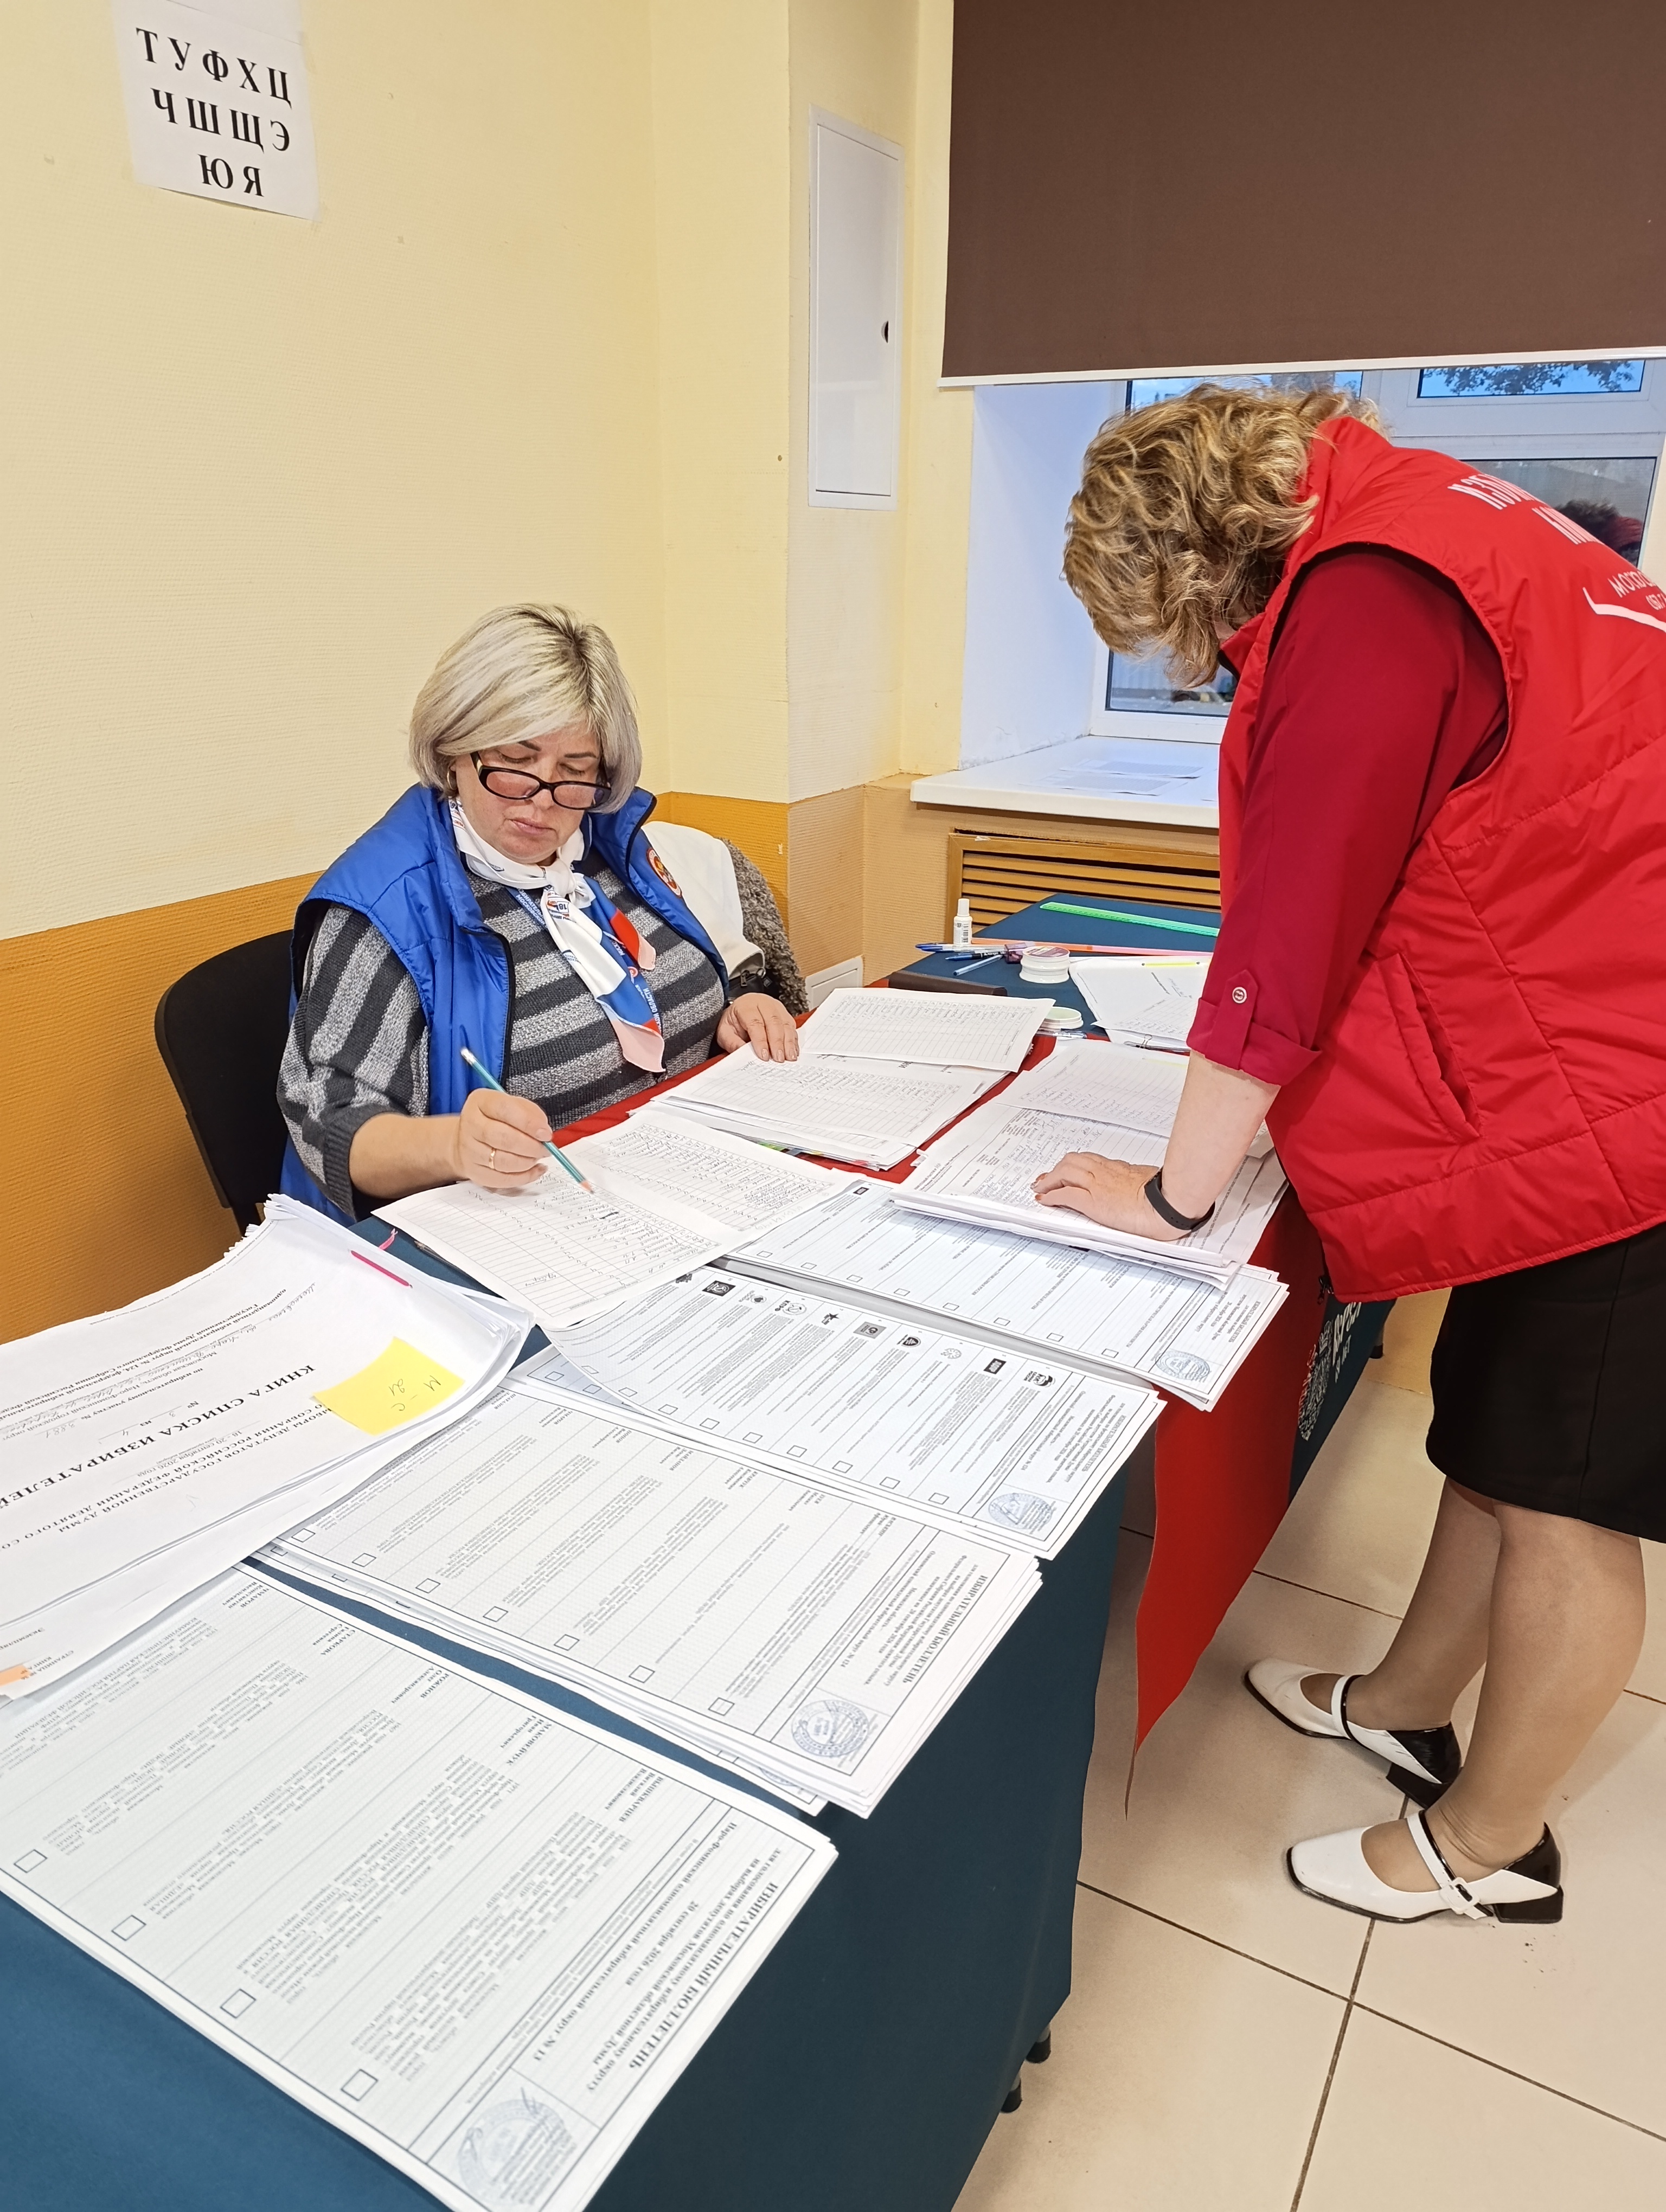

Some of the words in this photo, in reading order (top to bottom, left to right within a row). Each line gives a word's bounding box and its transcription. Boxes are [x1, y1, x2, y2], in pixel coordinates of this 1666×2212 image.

[136, 27, 158, 64] Т
[167, 36, 192, 72] У
[202, 49, 229, 82] Ф
[266, 66, 292, 110] Ц
[150, 87, 178, 124] Ч
[185, 97, 221, 135] Ш
[228, 108, 265, 153] Щ
[270, 119, 290, 151] Э
[197, 153, 234, 189] Ю
[243, 166, 265, 197] Я
[515, 893, 546, 925] МОСКОВСКОЙ
[643, 987, 658, 1013] ОБЛАСТИ
[196, 1303, 258, 1335] Государственной
[232, 1289, 286, 1323] одномандатный
[774, 1300, 790, 1311] КПРФ
[172, 1333, 195, 1346] Думы
[174, 1322, 232, 1351] избирательный
[116, 1345, 172, 1368] Федерального
[122, 1364, 139, 1372] 124,
[151, 1349, 174, 1360] округ
[172, 1351, 217, 1372] Московская
[65, 1371, 121, 1394] федеральный
[74, 1367, 116, 1385] Собрания
[127, 1372, 192, 1401] избирательному
[248, 1365, 314, 1396] КНИГА
[24, 1384, 74, 1405] Российской
[70, 1384, 140, 1413] Наро-Фоминский
[92, 1400, 126, 1416] участку
[187, 1400, 199, 1409] №
[26, 1411, 69, 1431] городской
[159, 1398, 244, 1435] СПИСКА
[254, 1409, 312, 1437] СОБРАНИЯ
[292, 1407, 331, 1427] ЫБОРЫ
[174, 1436, 252, 1472] РОССИЙСКОЙ
[178, 1442, 215, 1460] сентября
[224, 1426, 290, 1458] ДЕПУТАТОВ
[137, 1467, 156, 1477] года
[157, 1458, 176, 1469] 2026
[96, 1472, 170, 1506] ФЕДЕРАЦИИ
[102, 1458, 221, 1513] ГОСУДАРСТВЕННОЙ
[24, 1504, 91, 1539] ДЕВЯТОГО
[58, 1511, 97, 1533] ДУМЫ
[240, 1587, 269, 1607] ЧМАРОВ
[938, 1574, 988, 1636] ИЗБИРАТЕЛЬНЫЙ
[320, 1629, 355, 1655] СТАРКОВА
[902, 1635, 943, 1683] БЮЛЛЕТЕНЬ
[390, 1666, 434, 1703] Александрович
[420, 1673, 449, 1698] РОЖНОВ
[427, 1669, 443, 1682] Олег
[499, 1715, 536, 1748] Григорьевич
[527, 1718, 544, 1733] Иван
[506, 1724, 552, 1765] МАКОВЕЙЧУК
[618, 1776, 663, 1822] ВЫШКВАРЦЕВ
[682, 1822, 737, 1883] Наро-Фоминский
[749, 1858, 760, 1868] на
[768, 1848, 780, 1862] для
[723, 1868, 752, 1899] выборах
[732, 1862, 770, 1908] голосования
[631, 1883, 683, 1944] одномандатный
[687, 1900, 699, 1912] 20
[693, 1899, 725, 1939] депутатов
[723, 1908, 734, 1919] по
[657, 1911, 689, 1946] сентября
[694, 1882, 778, 1985] ИЗБИРАТЕЛЬНЫЙ
[642, 1947, 661, 1966] 2026
[652, 1942, 696, 1991] Московской
[671, 1919, 725, 1985] одномандатному
[576, 1944, 632, 2009] избирательный
[625, 1966, 643, 1985] года
[554, 2009, 577, 2034] округ
[614, 1987, 672, 2057] избирательному
[615, 1991, 653, 2036] областной
[629, 1986, 699, 2068] БЮЛЛЕТЕНЬ
[533, 2049, 545, 2061] 13
[543, 2039, 556, 2047] №
[592, 2036, 617, 2065] Думы
[587, 2059, 615, 2091] округу
